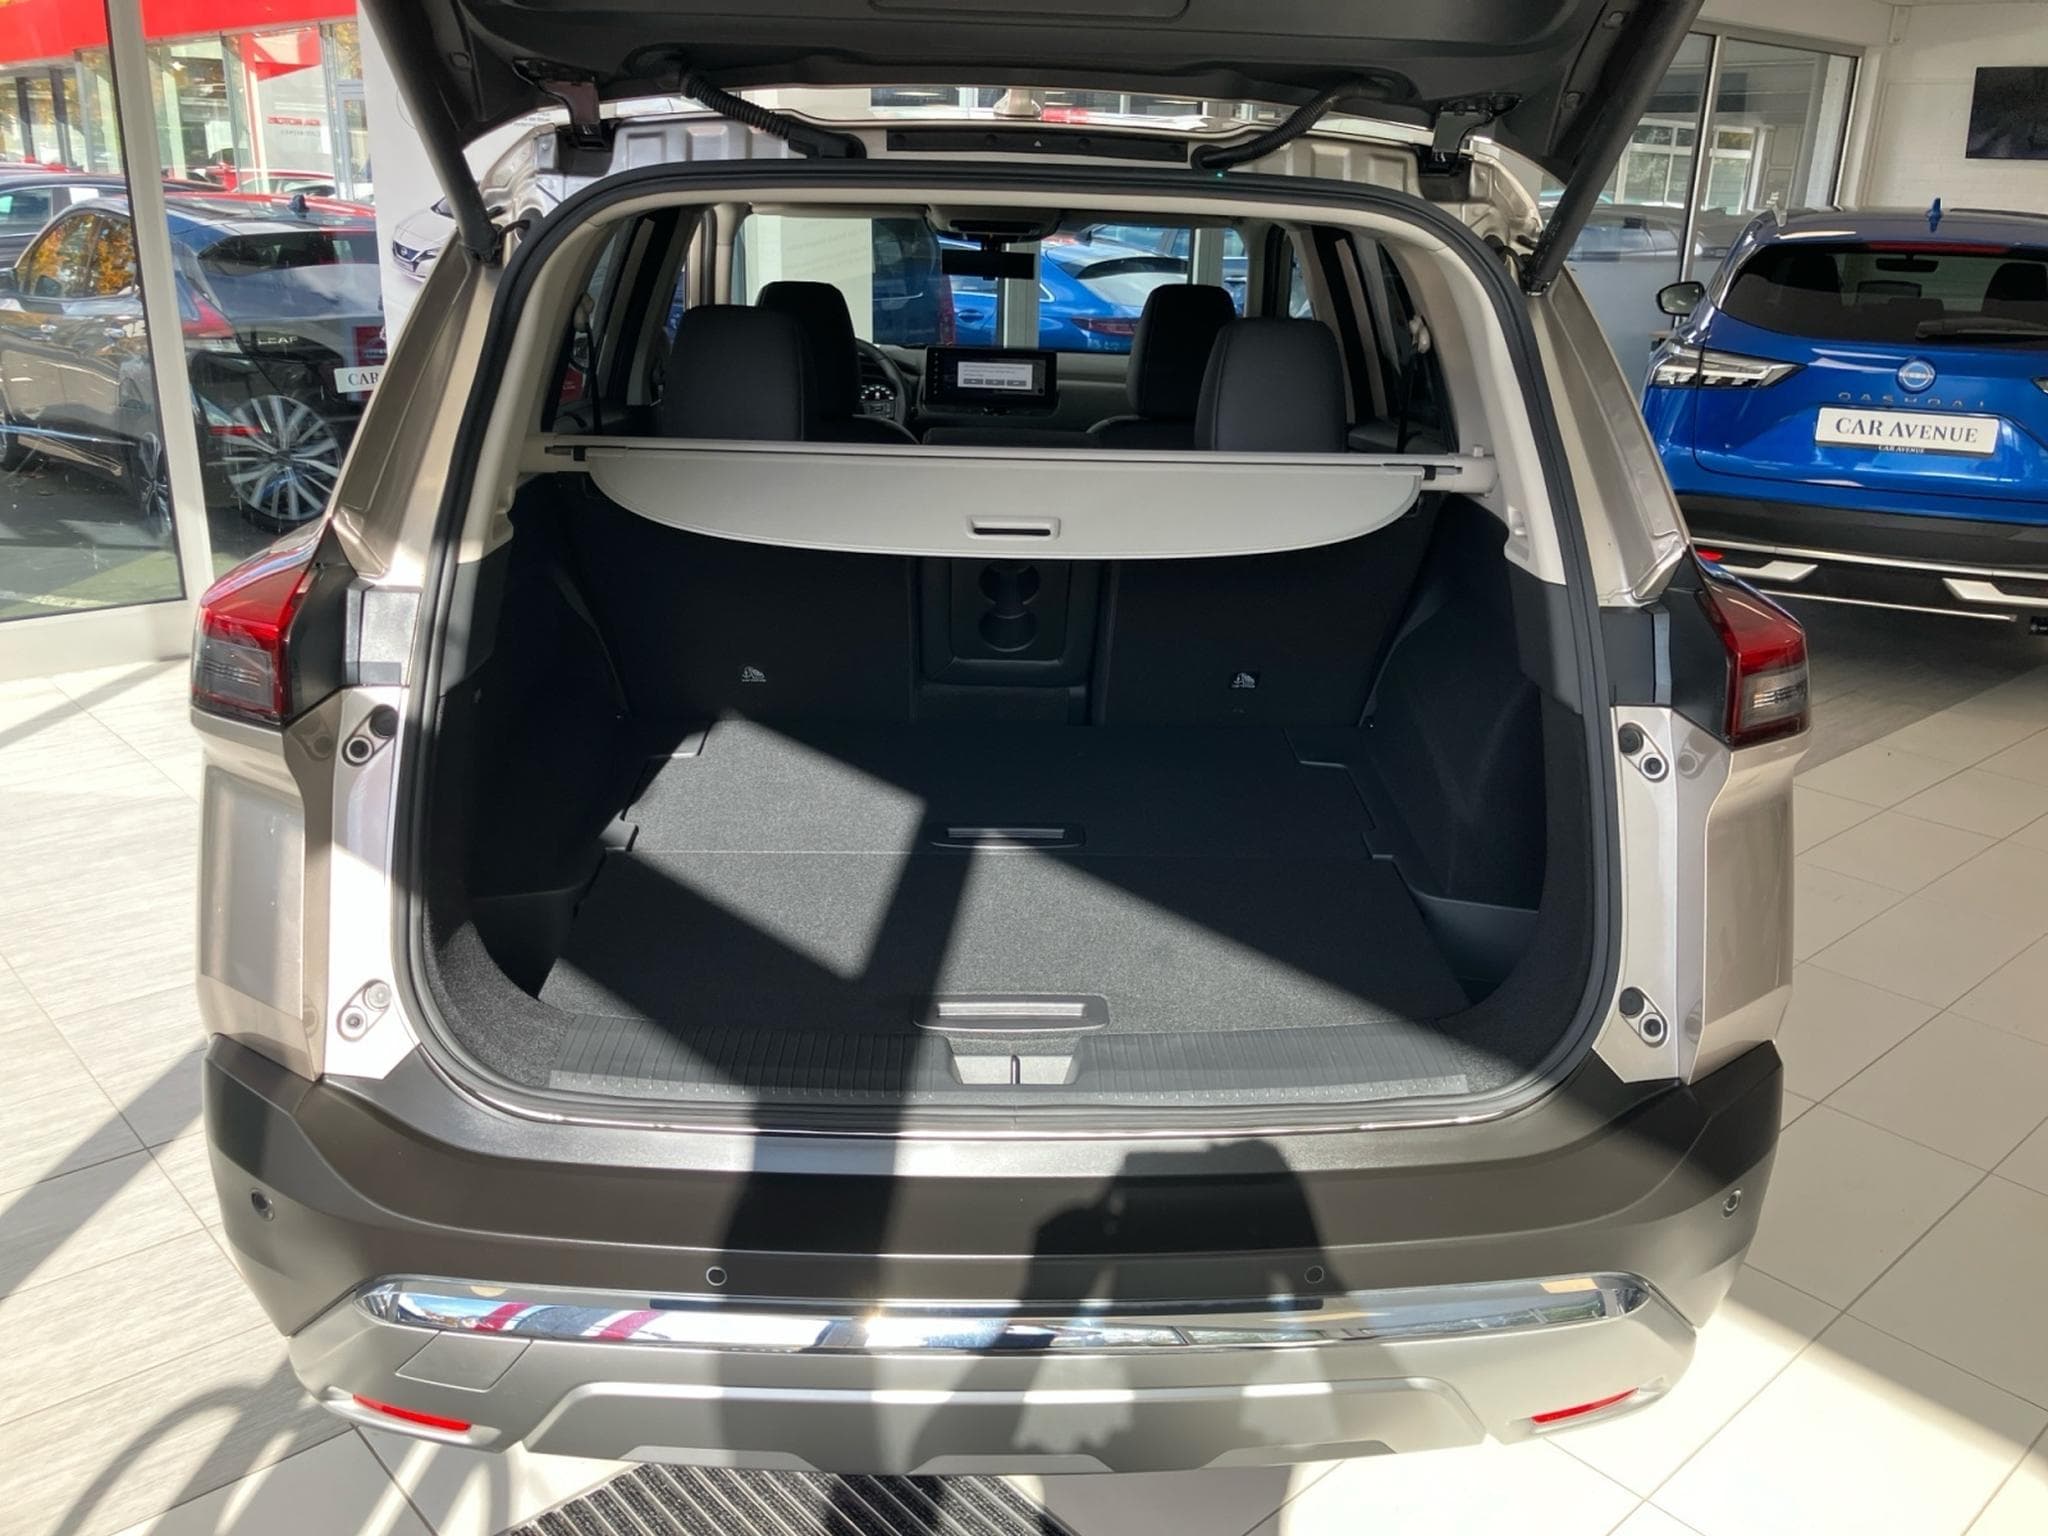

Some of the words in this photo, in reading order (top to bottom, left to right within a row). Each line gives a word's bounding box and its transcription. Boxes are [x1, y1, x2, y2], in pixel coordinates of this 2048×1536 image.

[257, 336, 298, 345] LEAF
[1835, 416, 1883, 437] CAR
[1889, 420, 1979, 443] AVENUE
